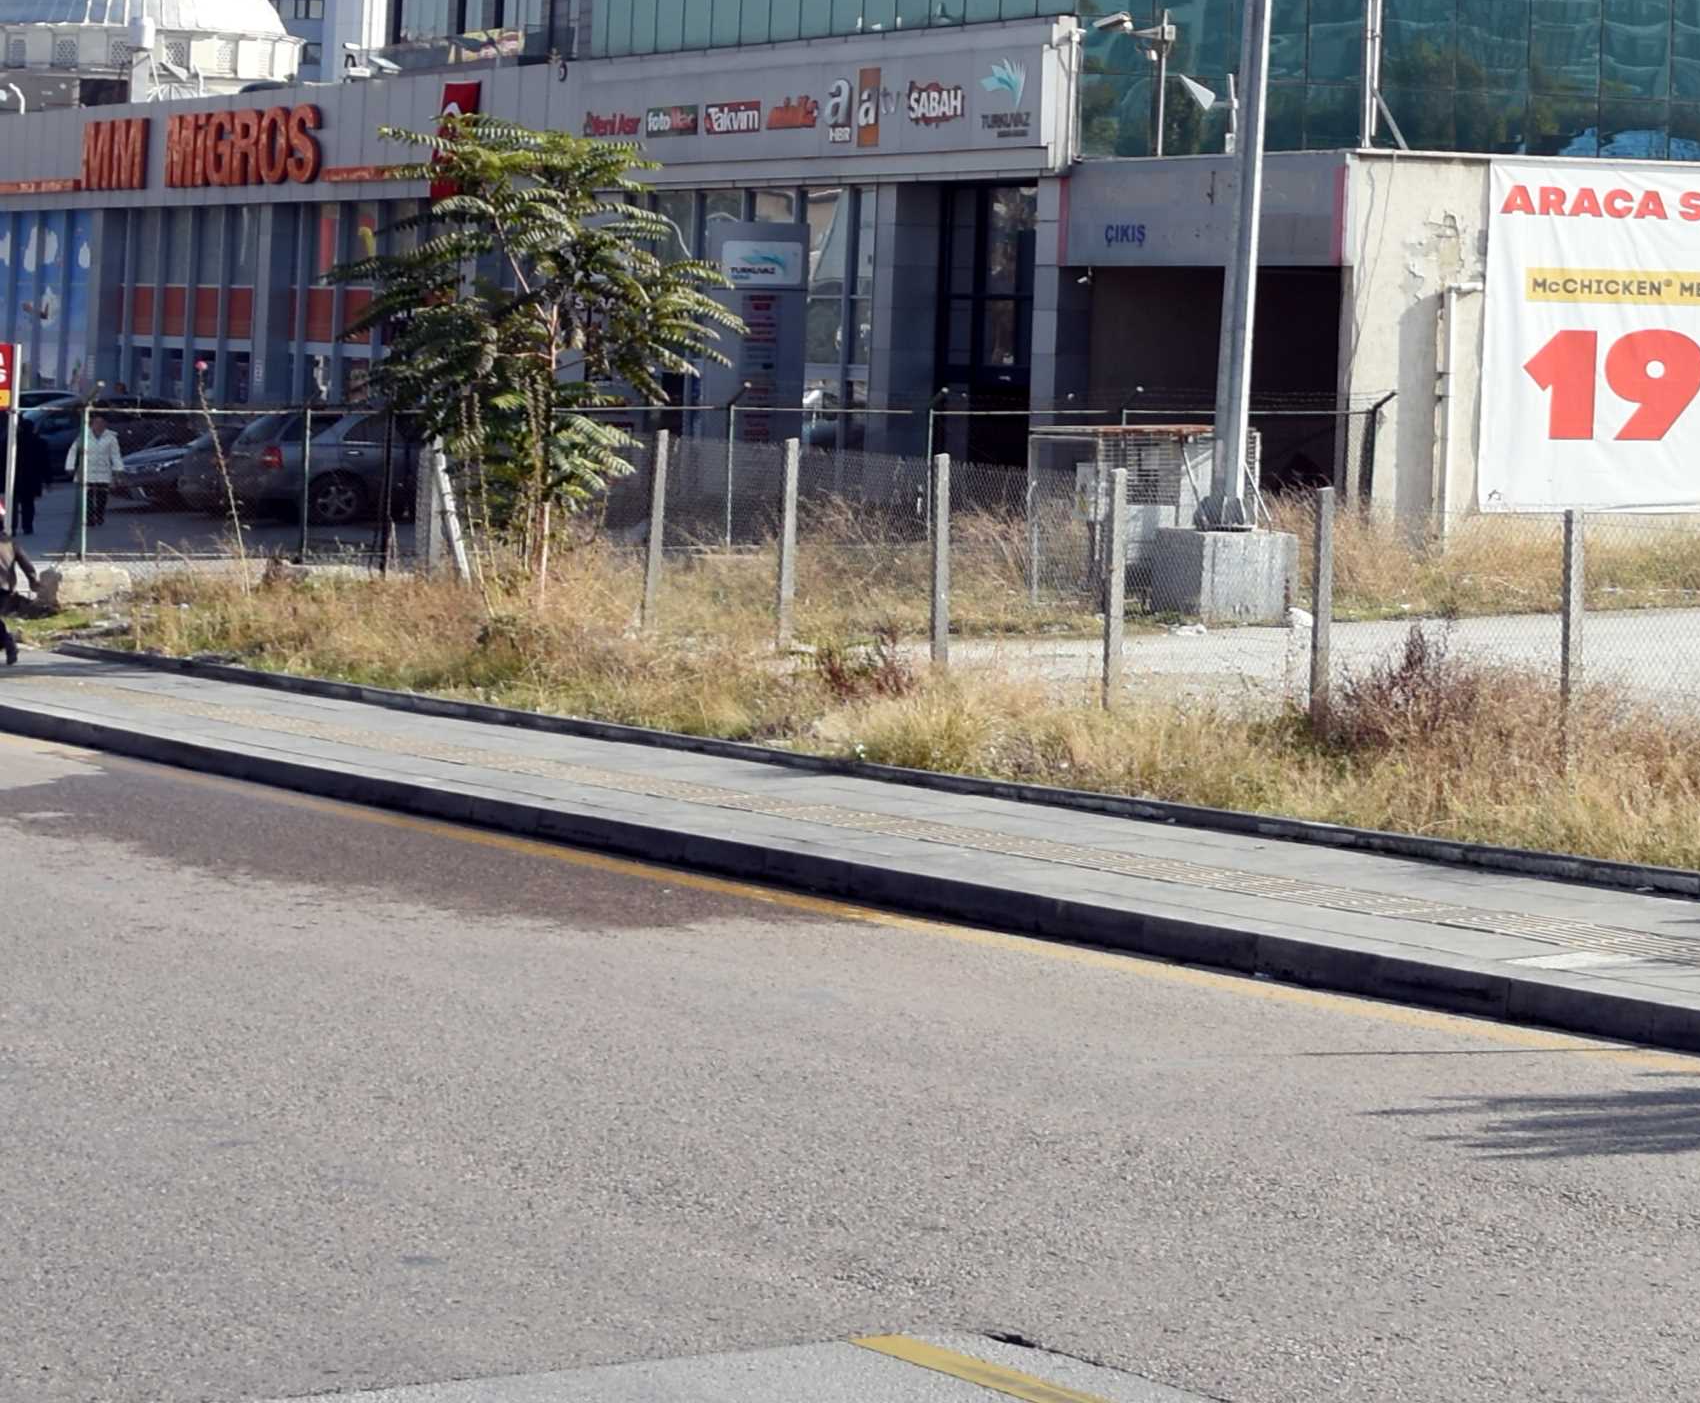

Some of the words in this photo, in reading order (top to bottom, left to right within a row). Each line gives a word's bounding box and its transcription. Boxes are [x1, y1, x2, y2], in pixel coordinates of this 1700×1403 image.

[909, 90, 963, 119] SABAH
[707, 106, 759, 132] Takvim
[1500, 184, 1668, 220] ARACA
[1104, 224, 1146, 248] ÇIKIŞ
